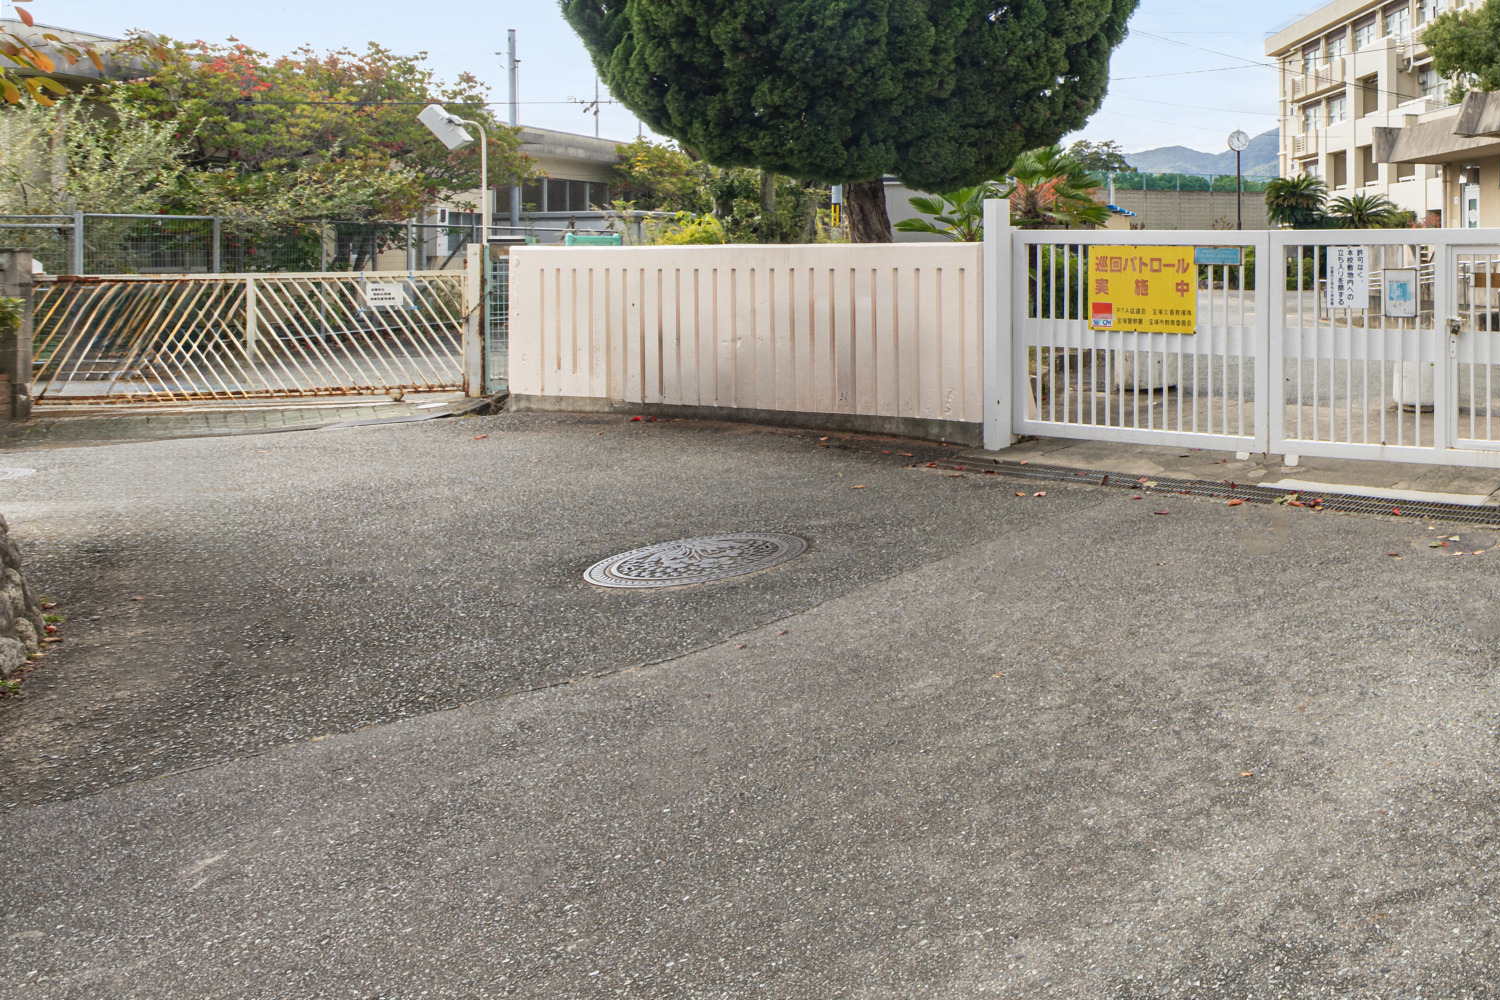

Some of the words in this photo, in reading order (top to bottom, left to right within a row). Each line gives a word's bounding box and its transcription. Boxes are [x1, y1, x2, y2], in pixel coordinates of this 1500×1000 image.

[1095, 256, 1191, 274] 巡回パトロール
